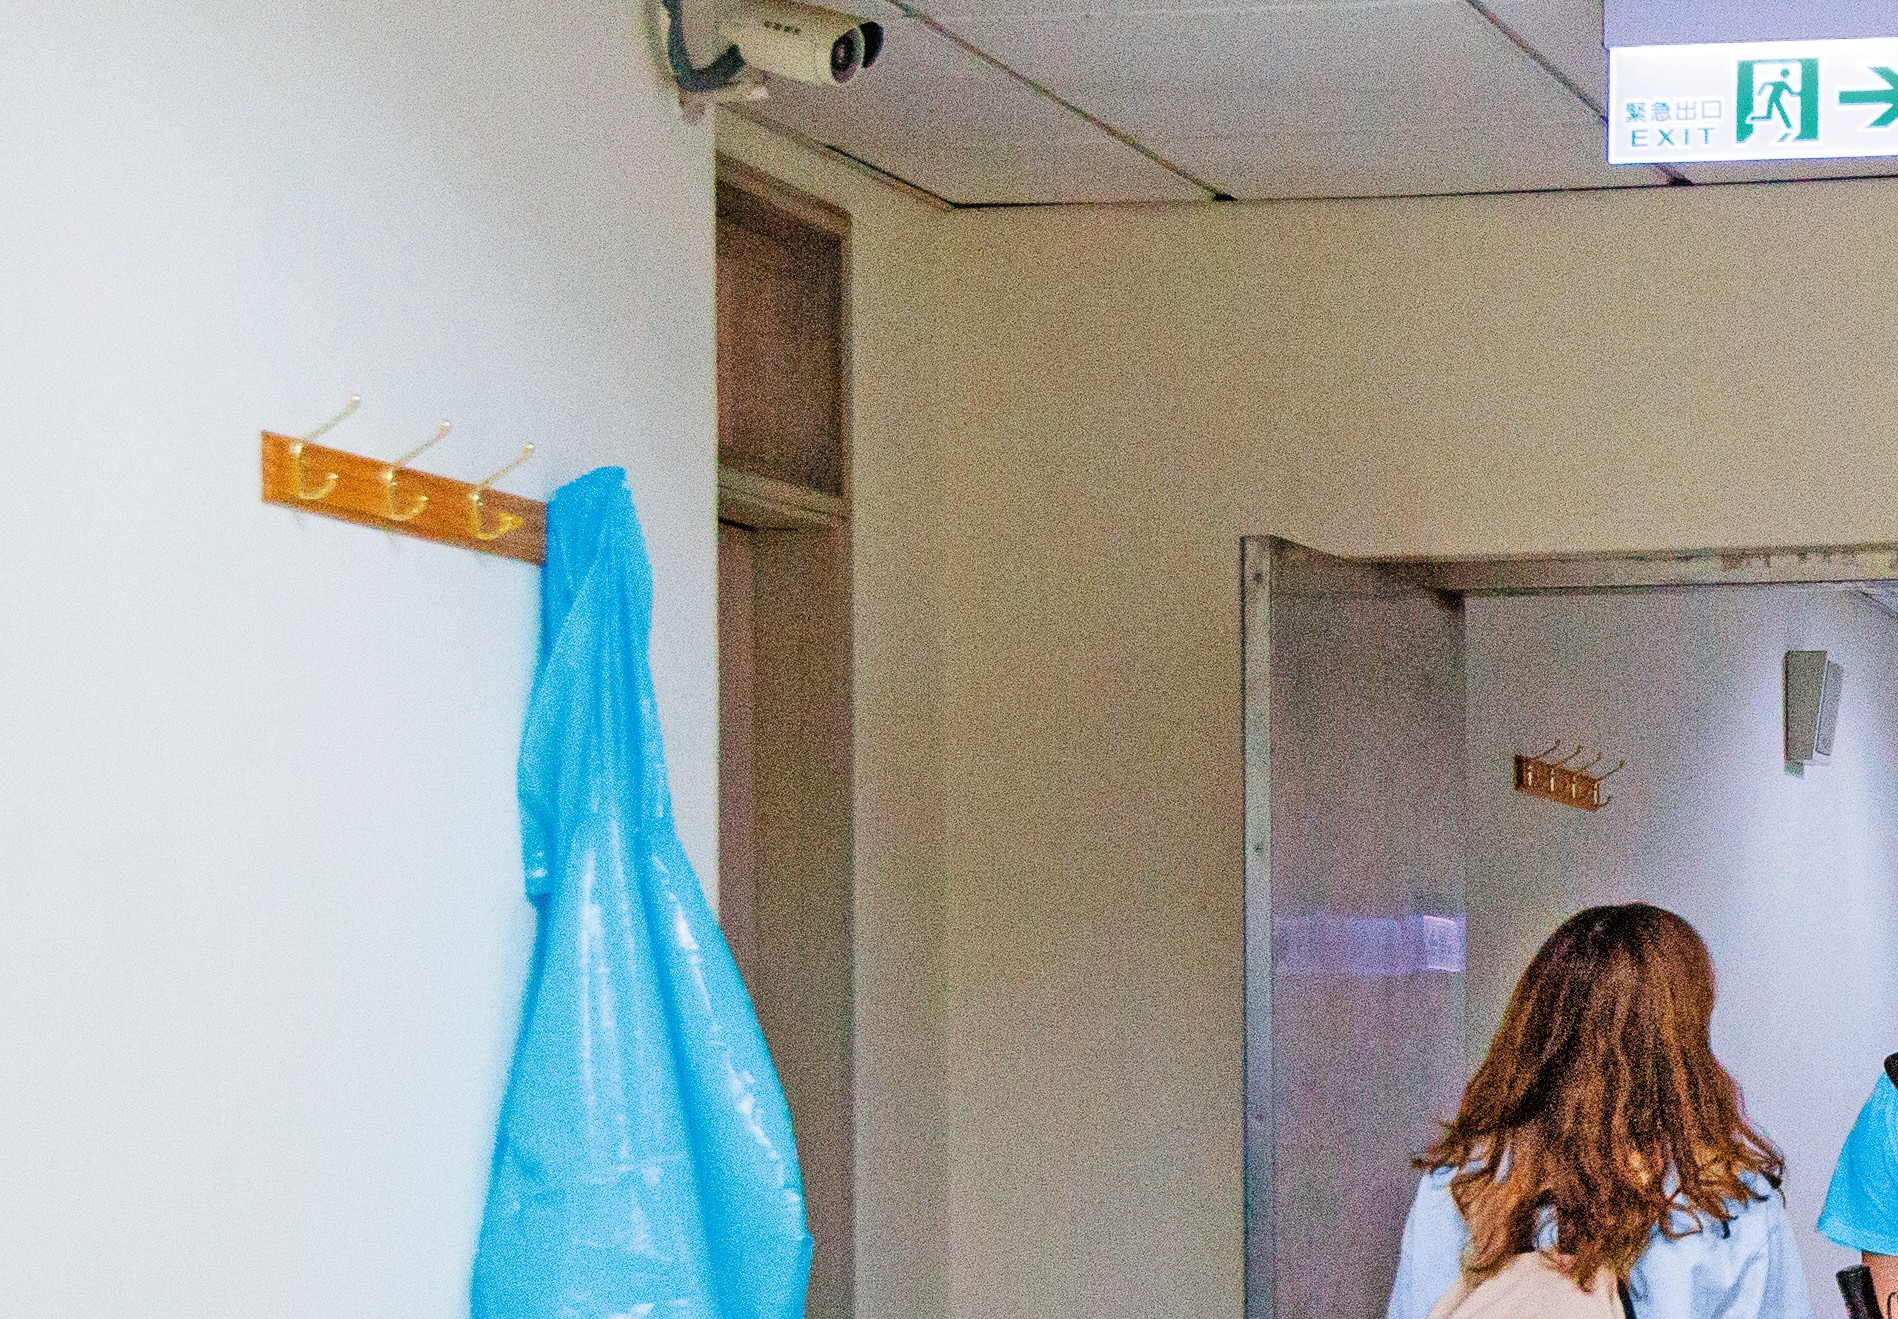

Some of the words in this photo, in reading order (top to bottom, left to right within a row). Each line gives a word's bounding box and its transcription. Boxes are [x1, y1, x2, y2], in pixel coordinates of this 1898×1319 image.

[1625, 100, 1722, 123] 緊急出口
[1631, 126, 1716, 147] EXIT
